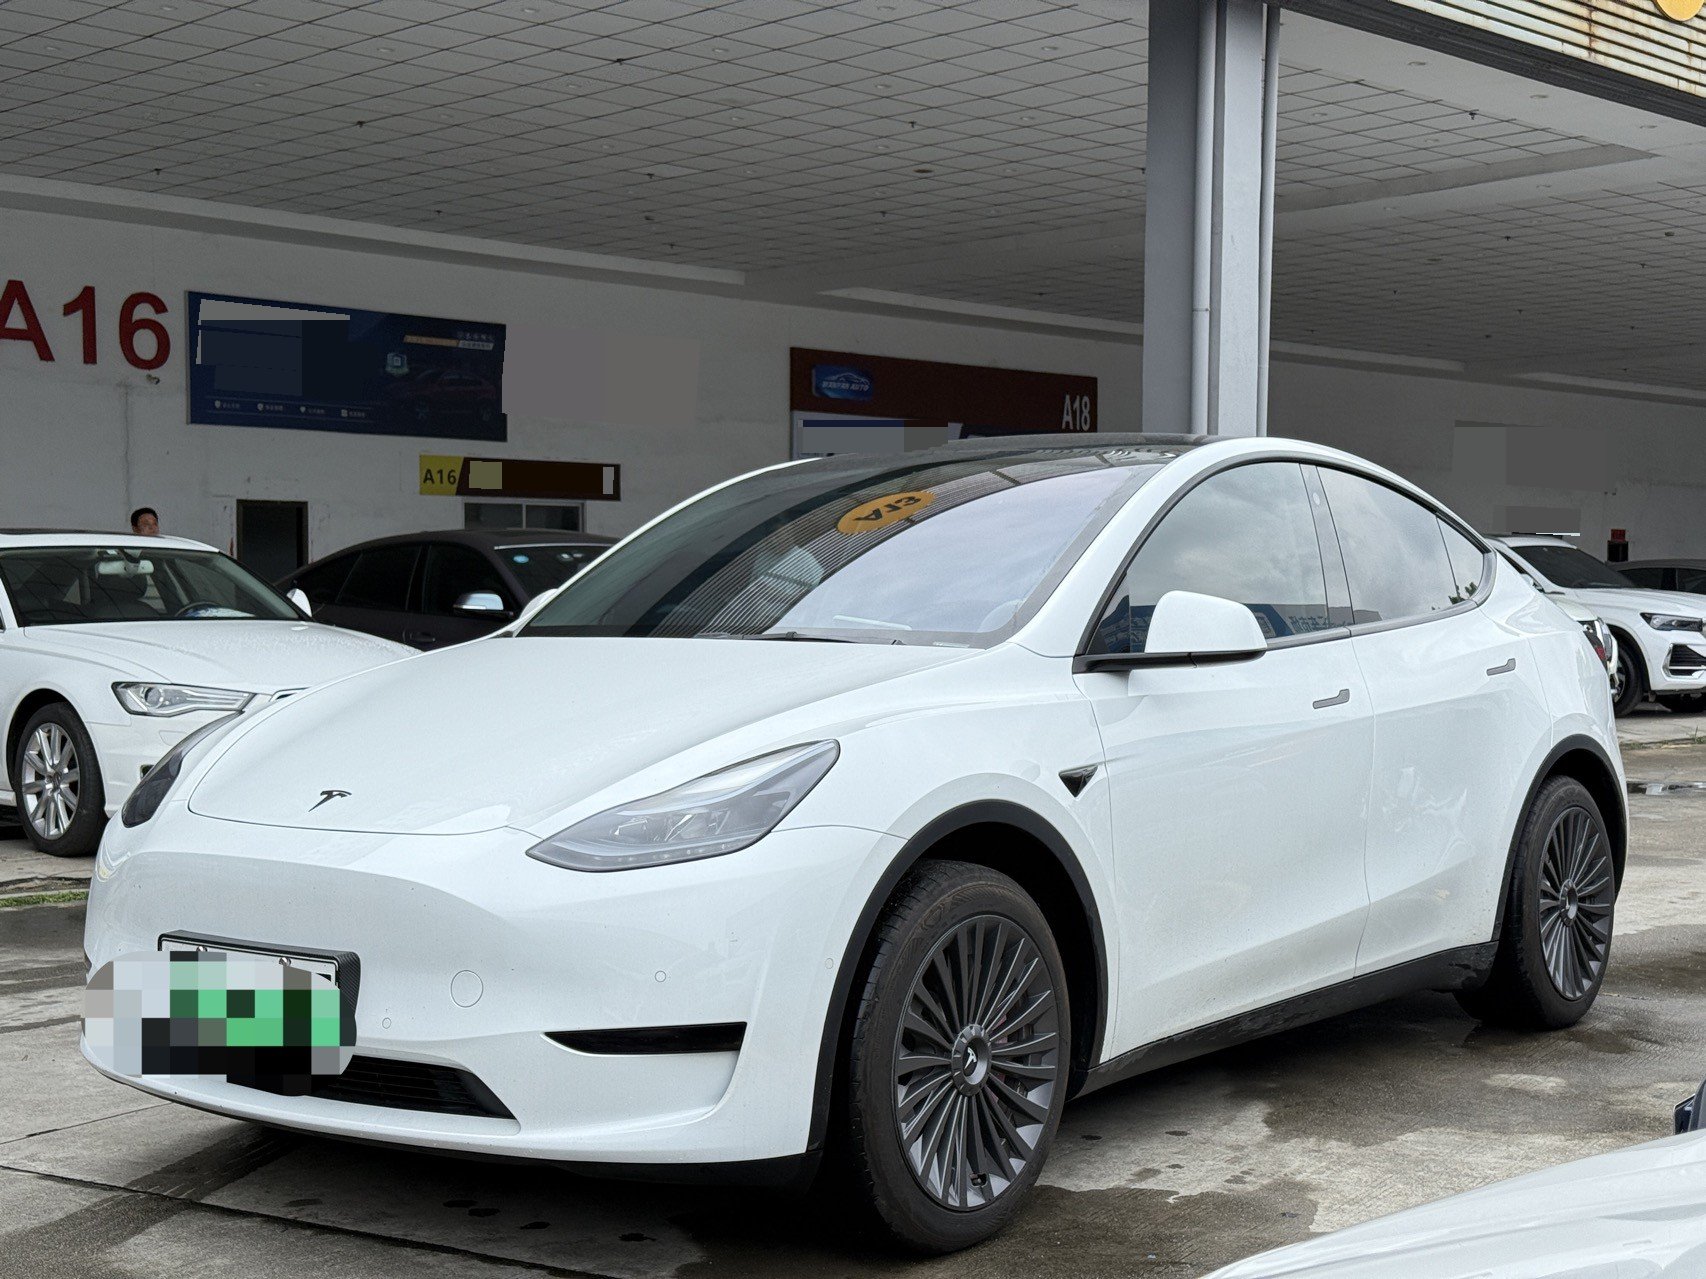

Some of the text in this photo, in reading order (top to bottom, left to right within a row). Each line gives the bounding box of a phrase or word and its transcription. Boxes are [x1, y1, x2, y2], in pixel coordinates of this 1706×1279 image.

[0, 279, 171, 370] A16
[1062, 395, 1091, 431] A18
[423, 469, 457, 485] A16
